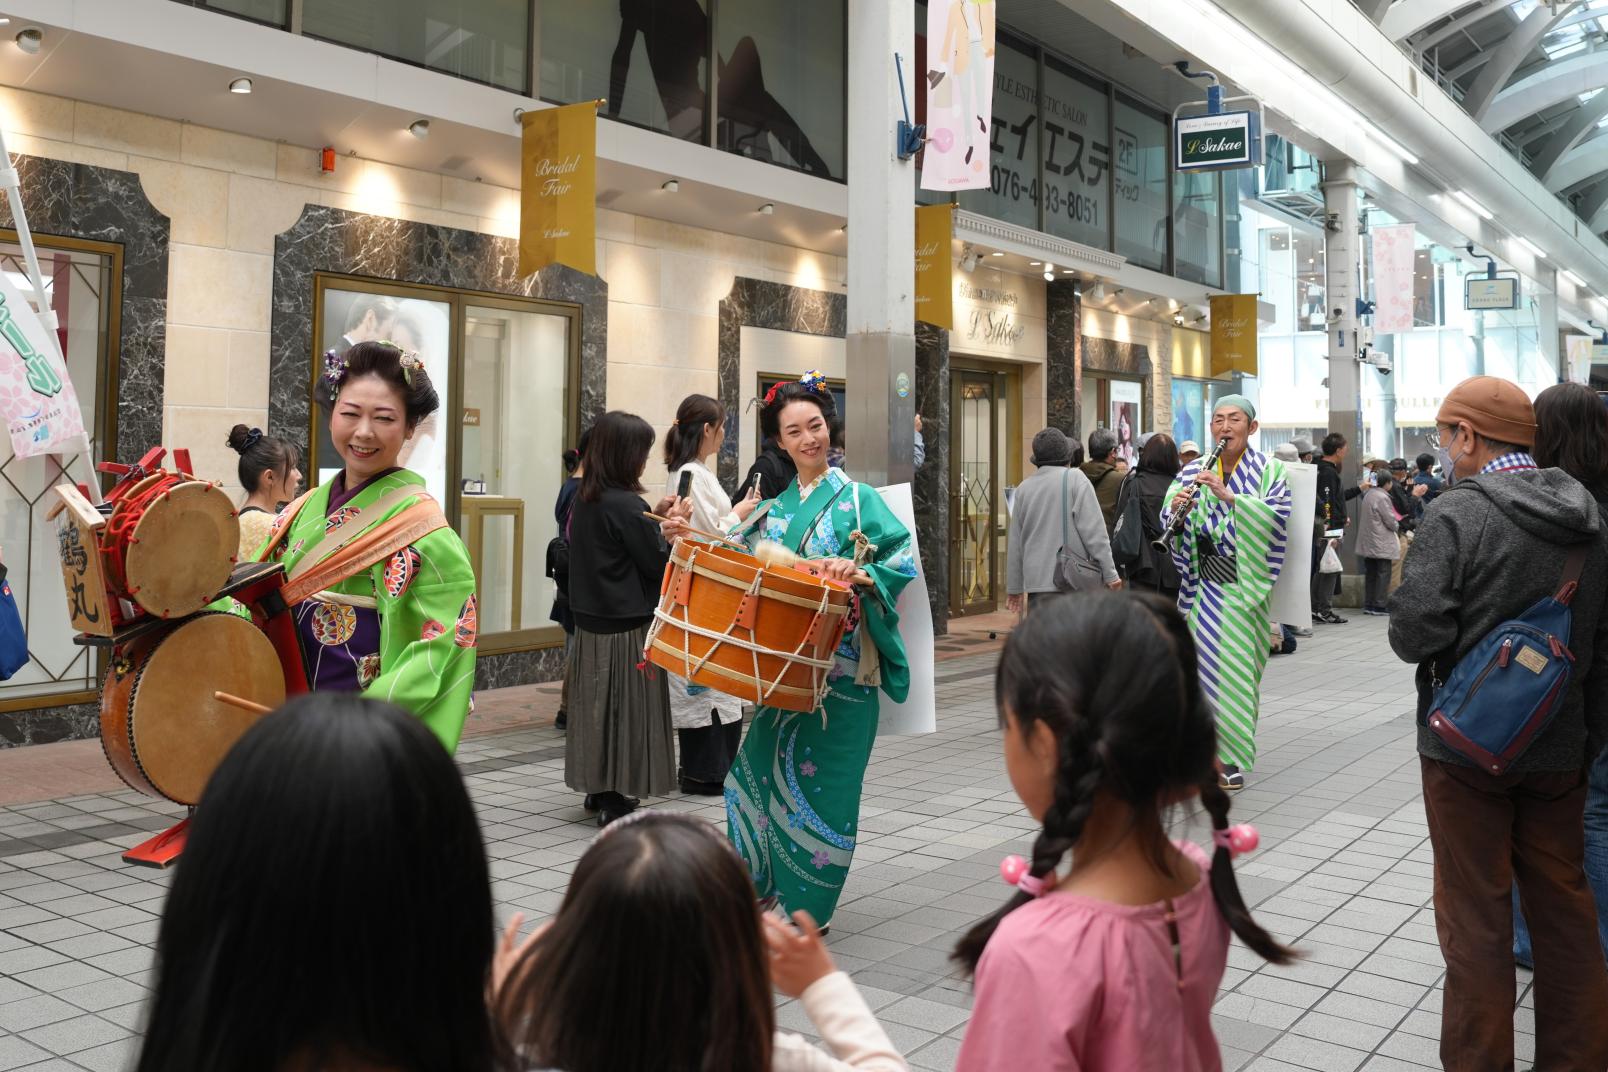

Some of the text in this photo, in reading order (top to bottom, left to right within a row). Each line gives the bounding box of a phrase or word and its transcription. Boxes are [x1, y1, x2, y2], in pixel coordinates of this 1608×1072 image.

[1063, 103, 1088, 126] SALON
[1119, 139, 1134, 166] 2F
[1199, 137, 1242, 153] Sakae
[535, 154, 581, 177] Bridal
[540, 178, 572, 197] Fair
